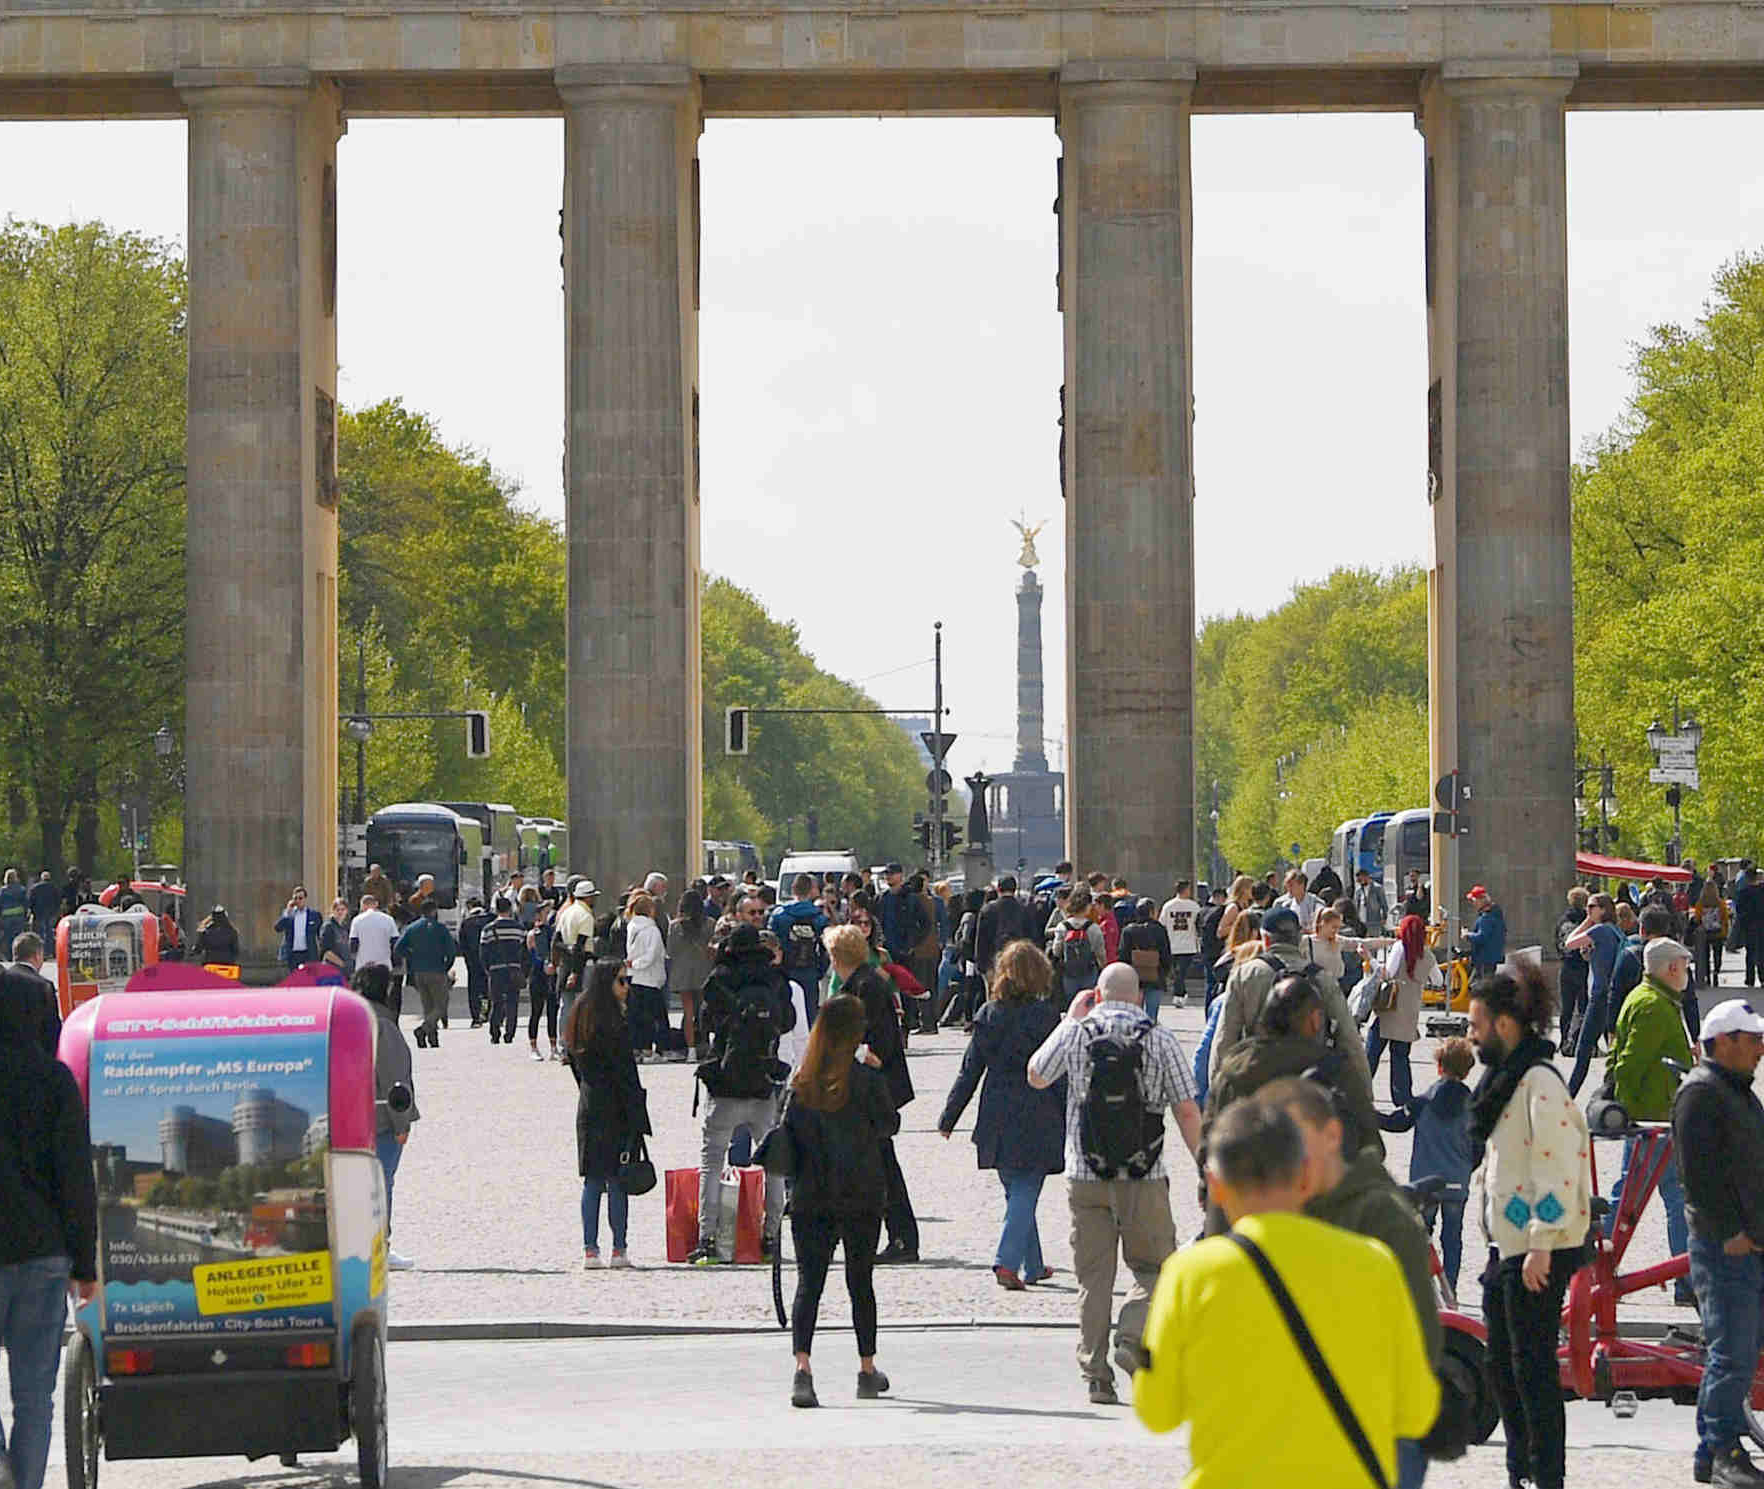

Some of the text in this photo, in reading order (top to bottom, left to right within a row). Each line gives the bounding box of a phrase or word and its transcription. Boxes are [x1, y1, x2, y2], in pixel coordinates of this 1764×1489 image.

[103, 1062, 203, 1080] Raddampfer
[125, 1083, 144, 1095] der
[148, 1082, 182, 1097] Spree
[186, 1080, 220, 1094] durch
[206, 1259, 321, 1283] ANLEGESTELLE
[207, 1282, 273, 1297] Holsteiner
[276, 1278, 304, 1291] Ufer
[131, 1300, 175, 1314] täglich
[114, 1318, 215, 1334] Brückenfahrten
[288, 1315, 324, 1329] Tours
